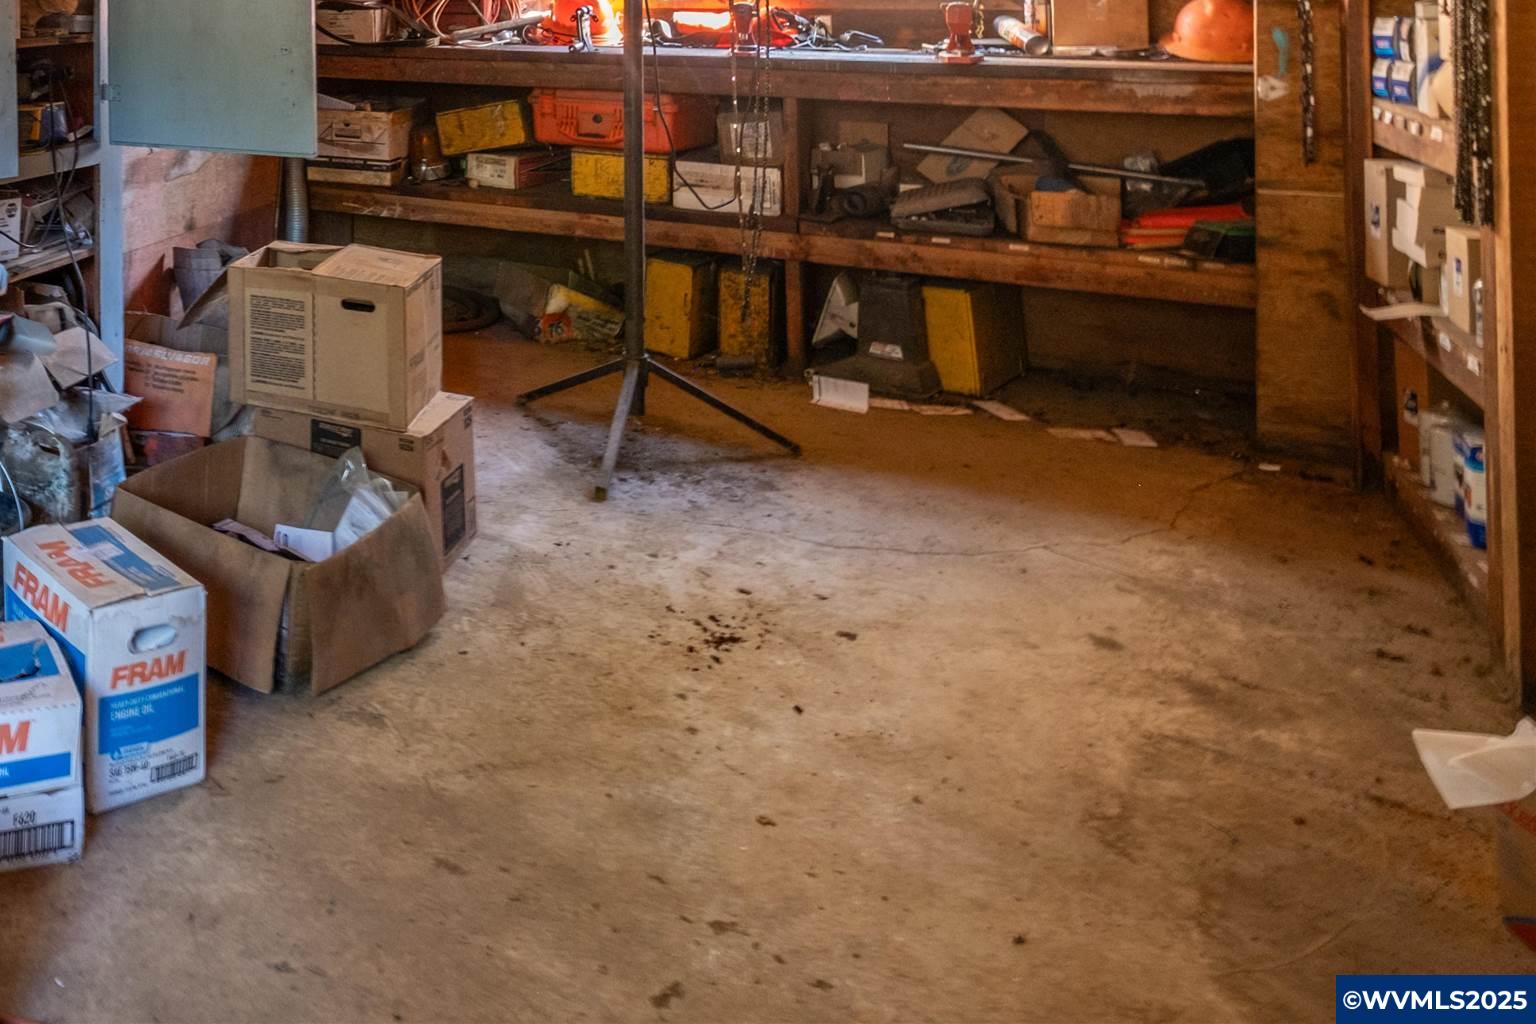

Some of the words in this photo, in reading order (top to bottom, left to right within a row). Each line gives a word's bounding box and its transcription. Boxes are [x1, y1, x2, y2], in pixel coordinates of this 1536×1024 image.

[11, 561, 71, 633] FRAM
[109, 650, 188, 690] FRAM
[110, 707, 140, 721] ENGINE
[141, 704, 155, 715] OIL
